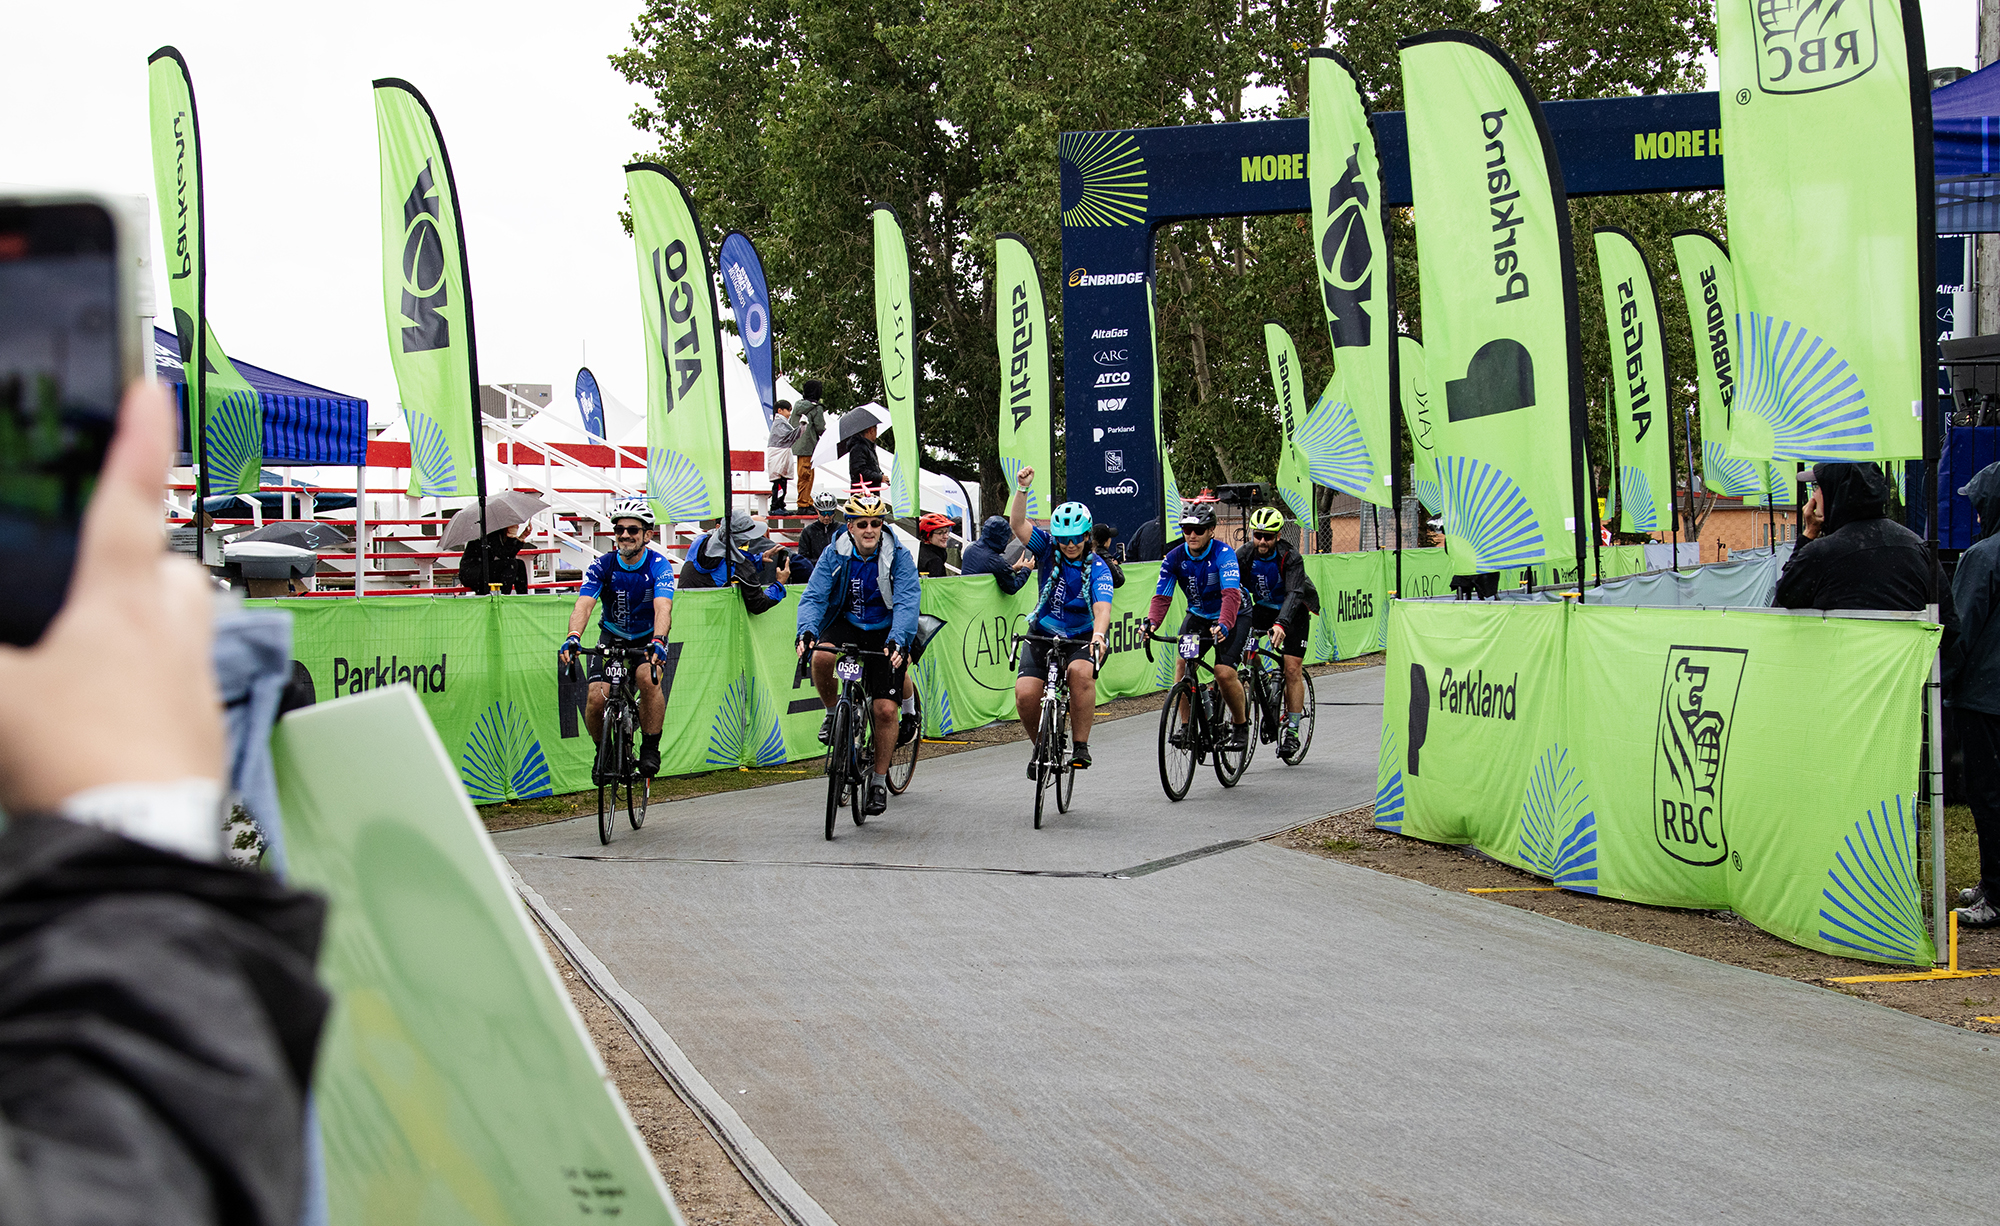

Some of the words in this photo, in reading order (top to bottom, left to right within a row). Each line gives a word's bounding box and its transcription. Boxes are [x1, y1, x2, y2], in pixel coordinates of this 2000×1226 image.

[1634, 129, 1705, 160] MORE
[1241, 153, 1304, 183] MORE
[1079, 271, 1144, 287] ENBRIDGE
[1091, 328, 1129, 339] AltaGas
[1099, 348, 1129, 362] ARC
[1095, 371, 1131, 385] ATCO
[1097, 398, 1128, 412] NOV
[1107, 425, 1136, 434] Parkland
[1094, 485, 1134, 496] SUNCOR
[1337, 588, 1374, 623] AltaGas
[838, 661, 860, 674] 0583
[331, 653, 447, 699] Parkland
[1439, 667, 1518, 720] Parkland
[1661, 798, 1718, 849] RBC
